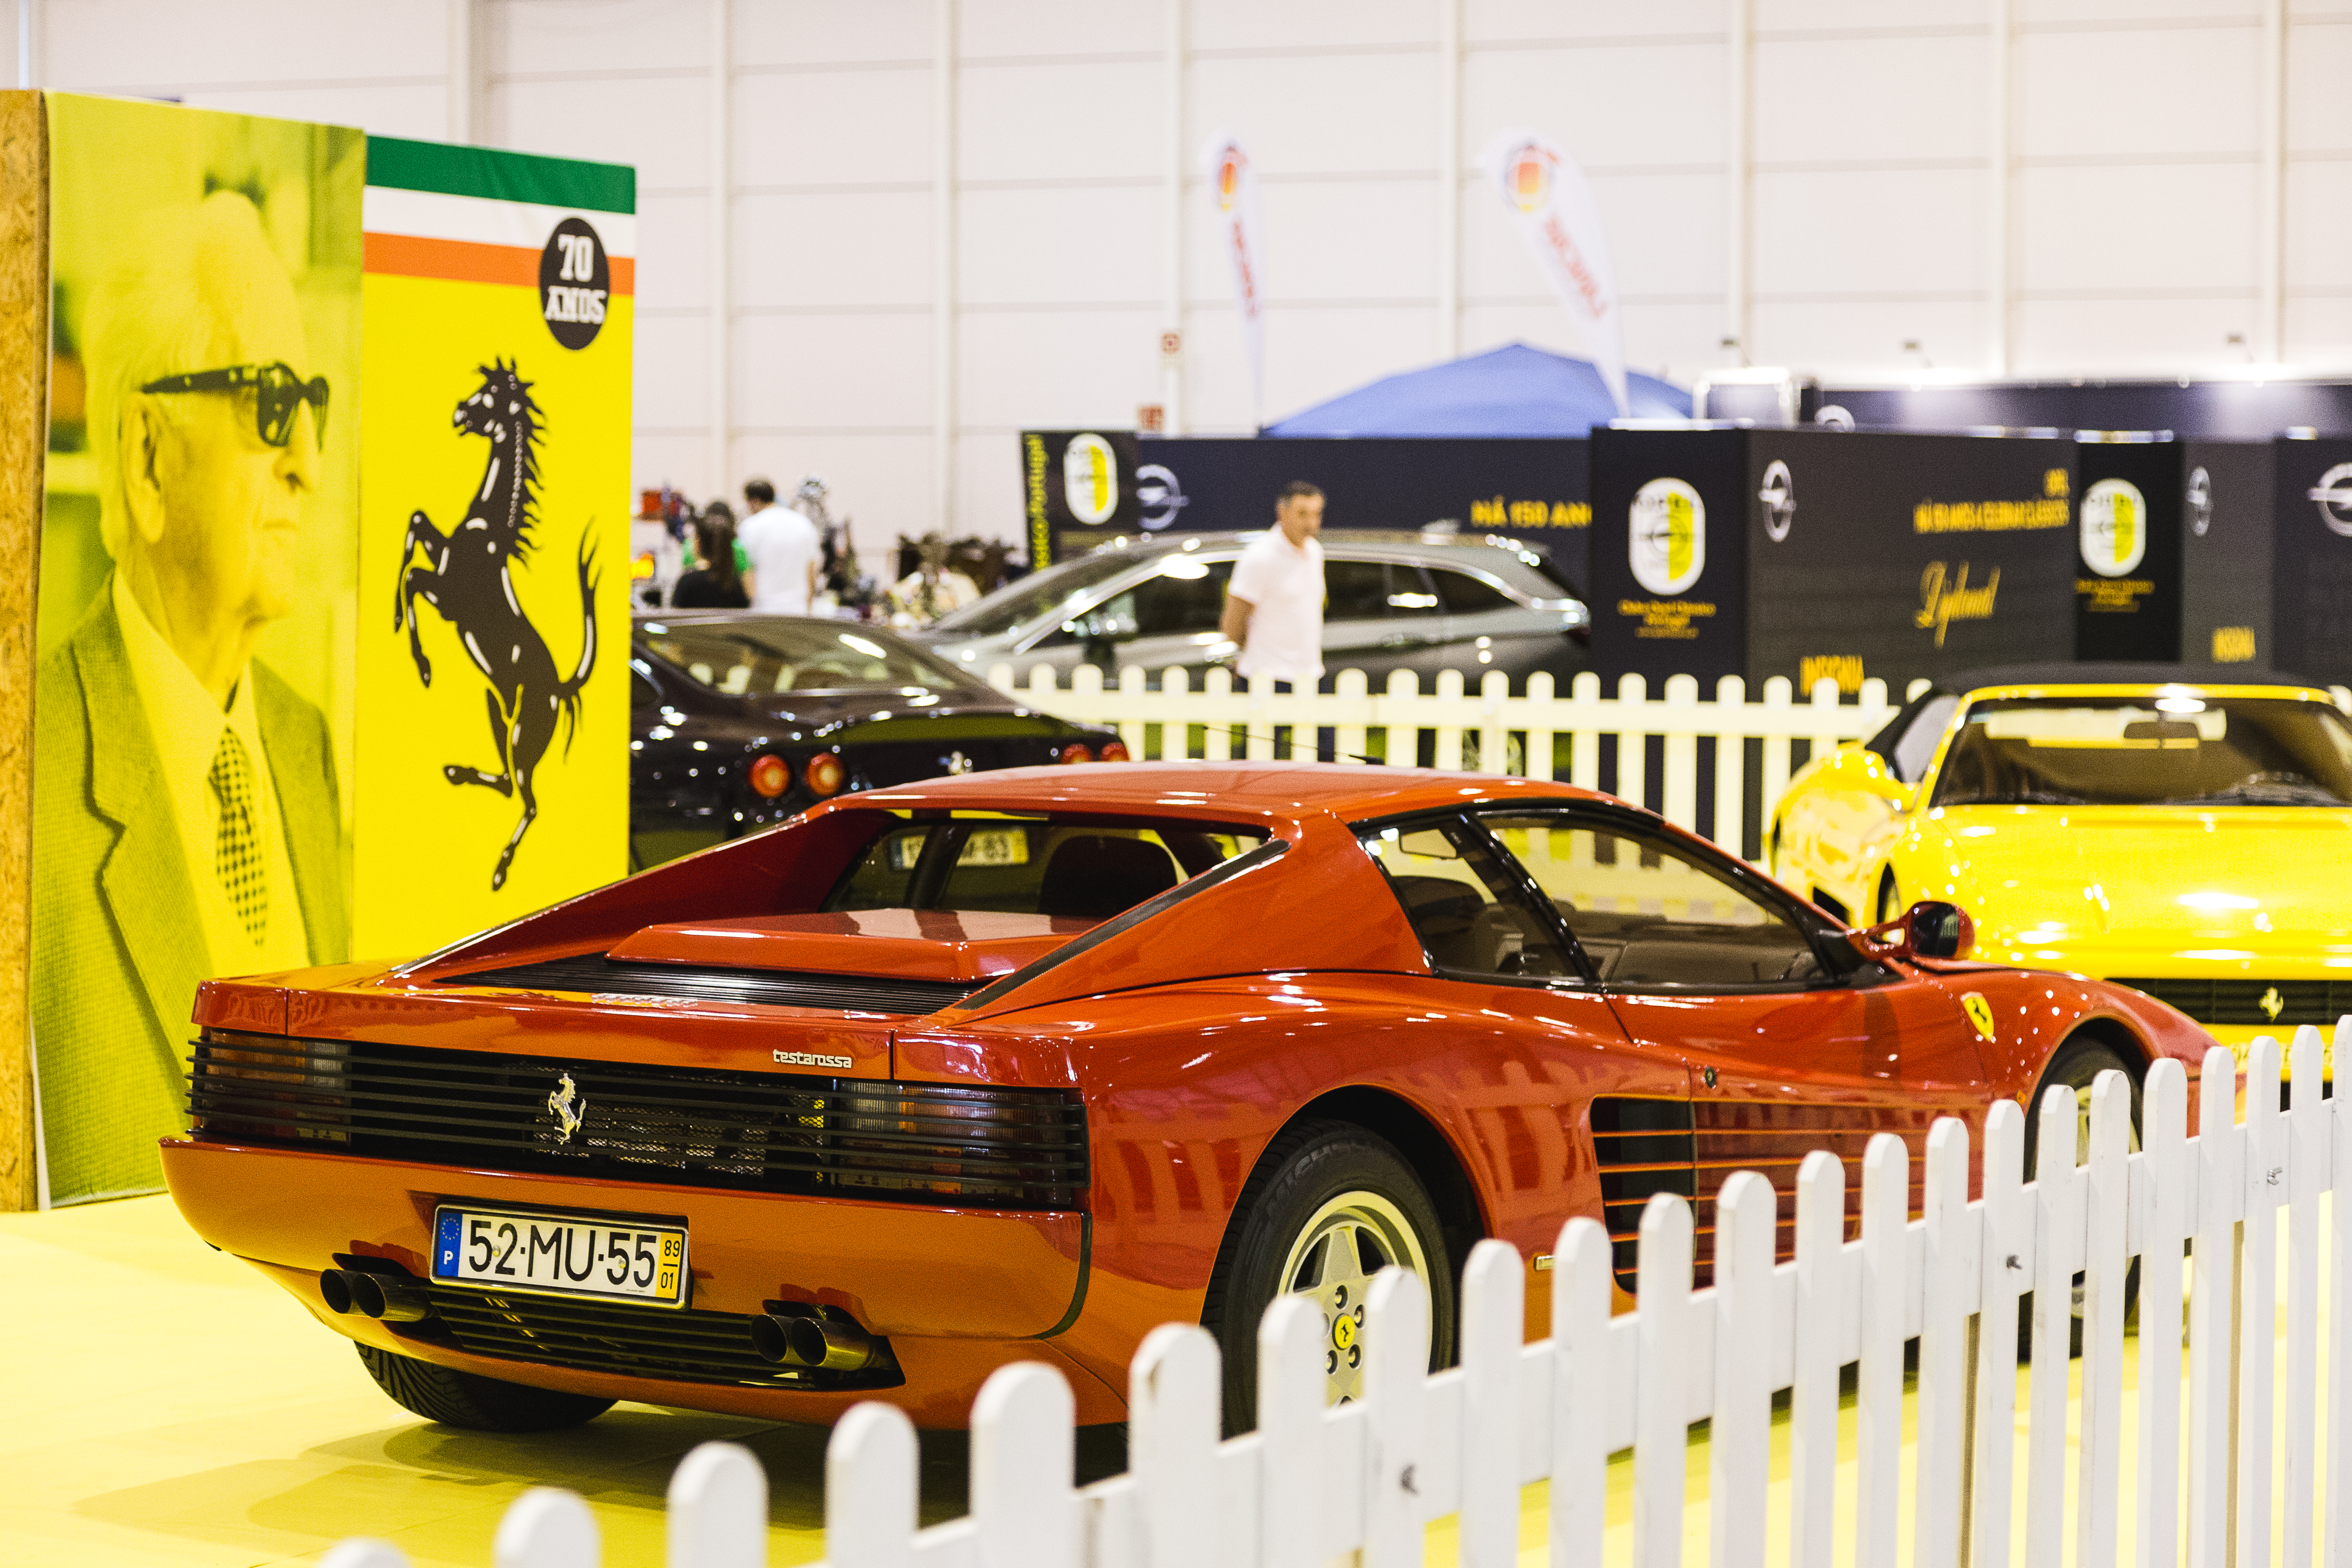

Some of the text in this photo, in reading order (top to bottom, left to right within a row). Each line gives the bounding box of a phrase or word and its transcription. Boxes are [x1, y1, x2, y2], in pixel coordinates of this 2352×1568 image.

[558, 234, 594, 282] 70
[545, 285, 607, 324] ANOS
[772, 1049, 852, 1069] testarossa
[443, 1250, 454, 1265] P
[664, 1239, 681, 1258] 89
[660, 1271, 673, 1290] 01
